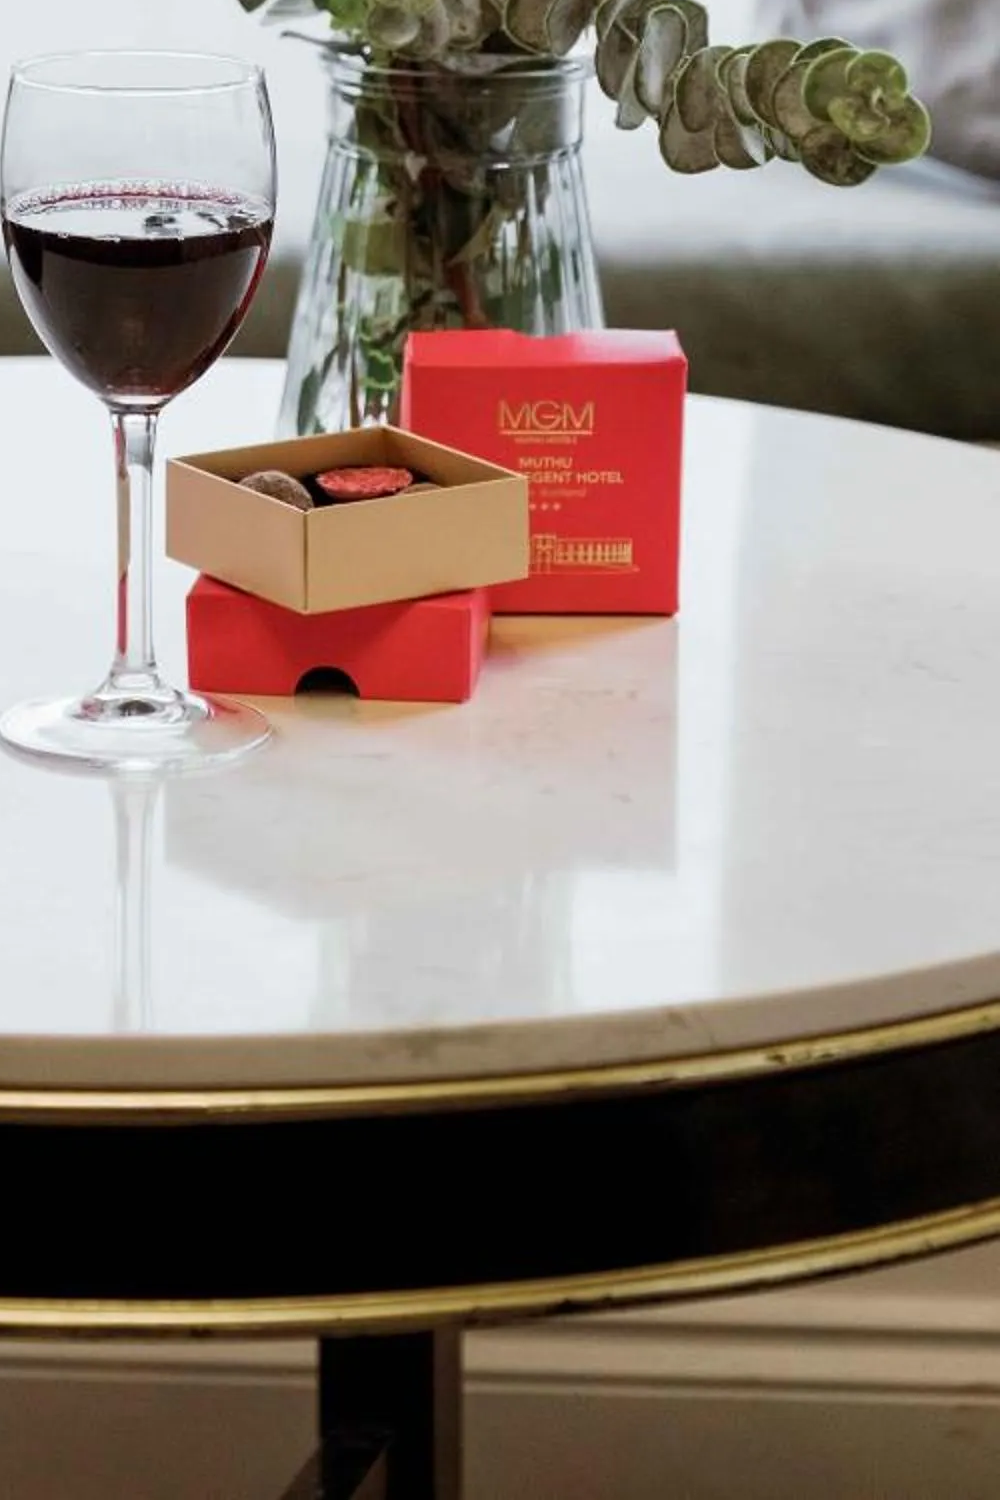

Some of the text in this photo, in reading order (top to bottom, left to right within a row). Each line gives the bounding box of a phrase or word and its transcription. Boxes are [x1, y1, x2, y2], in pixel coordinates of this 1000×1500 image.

[499, 400, 594, 429] MGM
[518, 457, 573, 469] MUTHU
[525, 471, 624, 484] EGENT HOTEL
